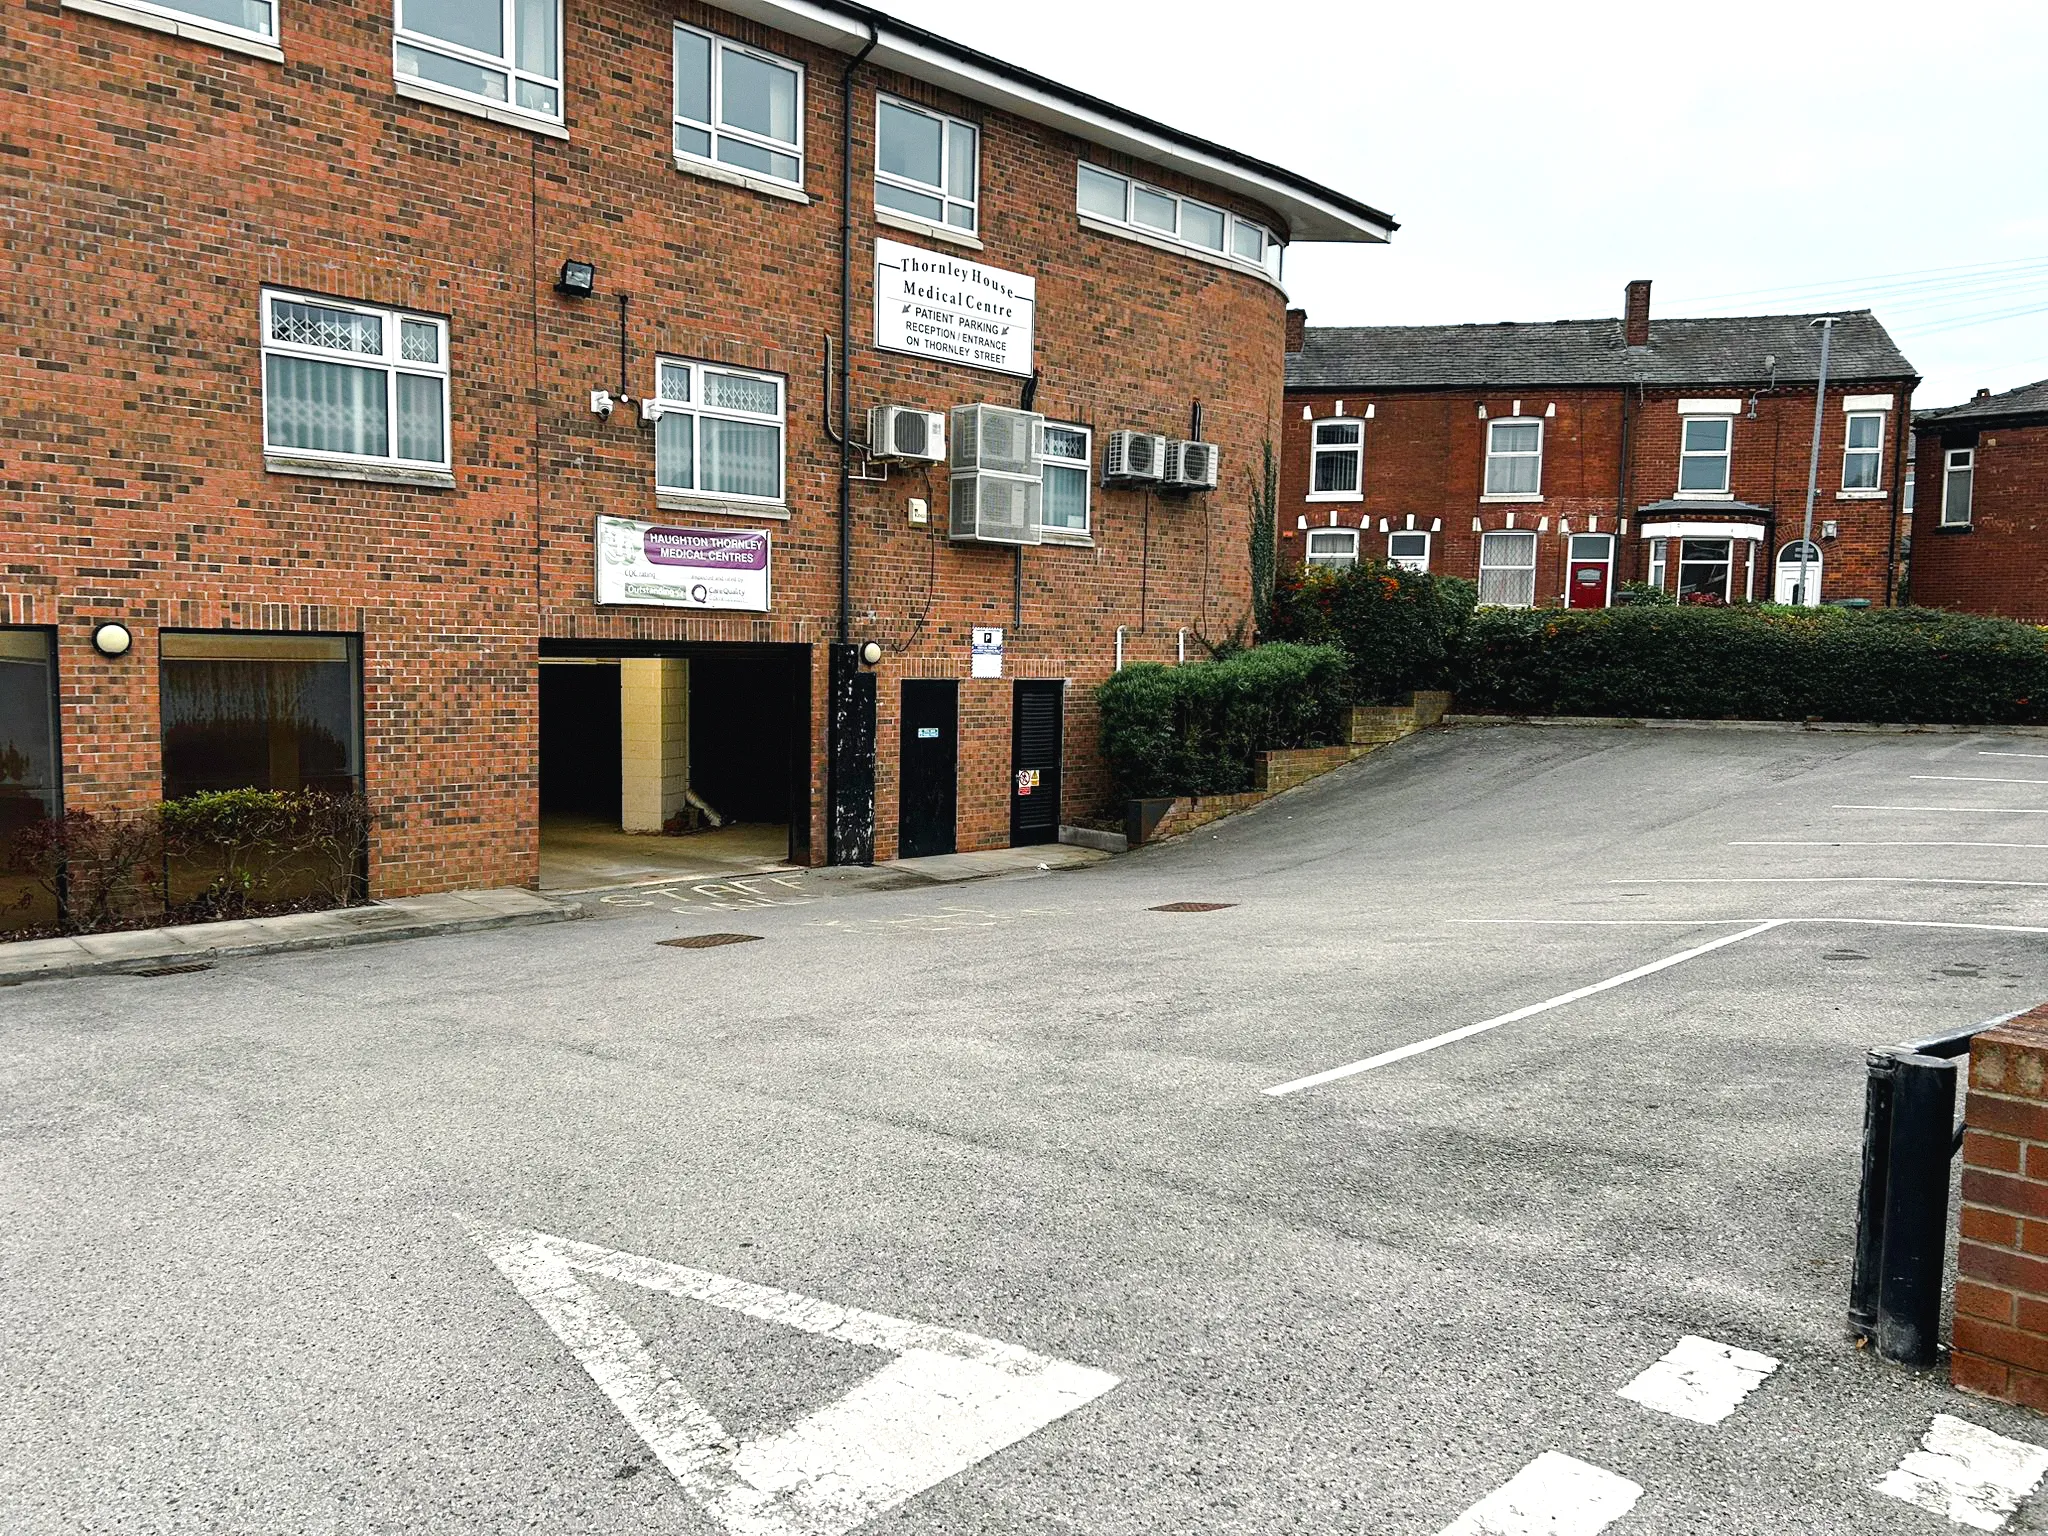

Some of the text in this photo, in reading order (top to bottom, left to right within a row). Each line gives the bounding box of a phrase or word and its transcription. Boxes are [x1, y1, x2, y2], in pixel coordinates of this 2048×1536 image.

[901, 258, 1013, 298] Thornley House
[904, 280, 1012, 318] Medical Centre
[915, 307, 999, 335] PATIENT PARKING
[906, 321, 956, 340] RECEPTION
[962, 333, 1007, 351] ENTRANCE
[906, 336, 1006, 364] ON THORNLEY STREET
[650, 533, 709, 548] HAUGHTON
[710, 537, 763, 551] THORNLEY
[660, 548, 754, 564] MEDICAL CENTRES
[600, 874, 807, 907] STAFF
